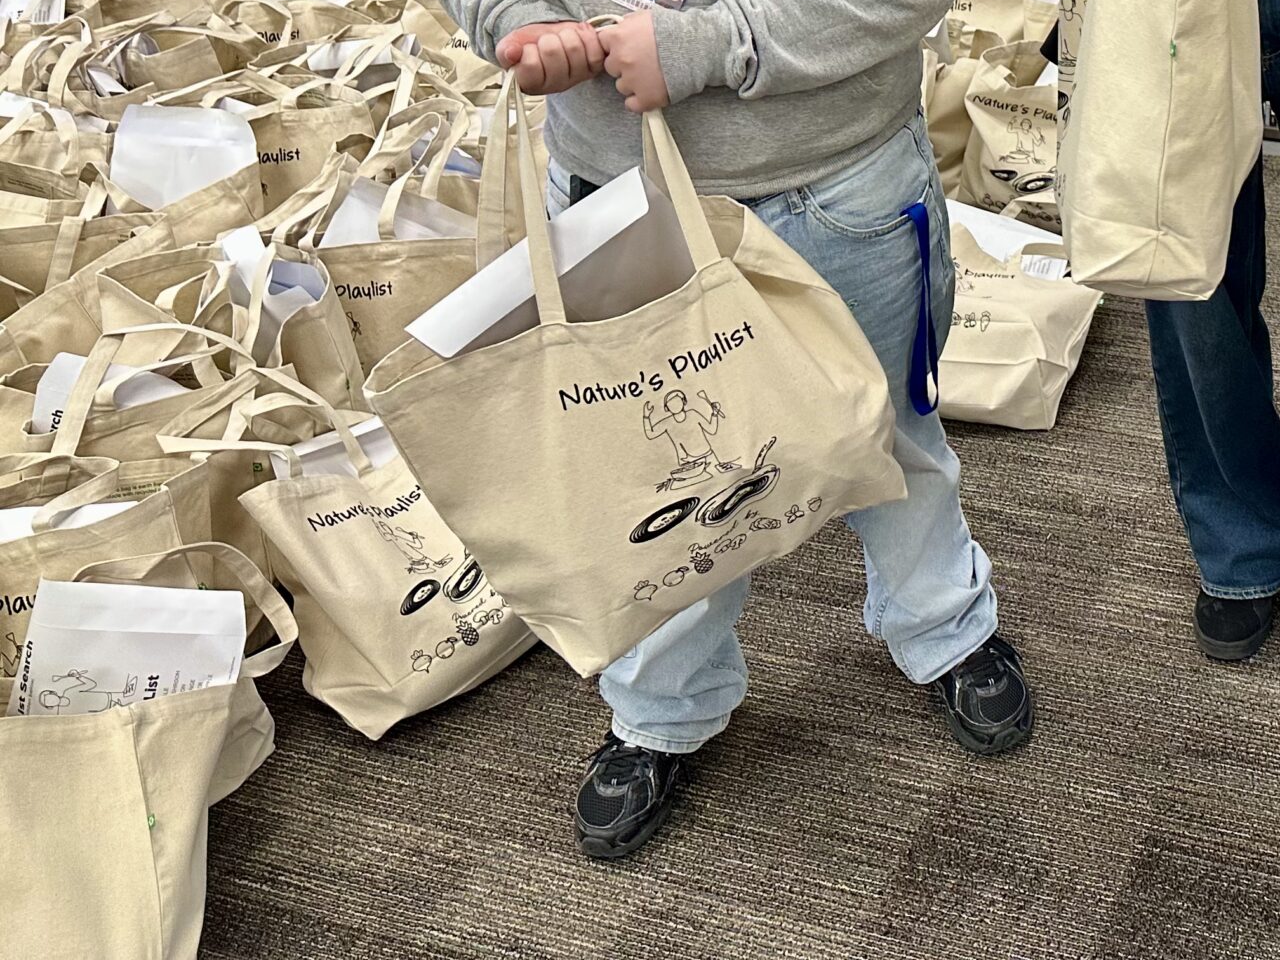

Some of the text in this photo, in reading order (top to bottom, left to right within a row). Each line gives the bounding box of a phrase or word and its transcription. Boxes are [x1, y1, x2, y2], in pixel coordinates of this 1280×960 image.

[972, 95, 1058, 125] Nature's Play
[258, 148, 301, 165] laylist
[335, 281, 393, 300] Playlist
[559, 321, 756, 411] Nature's Playlist
[45, 407, 64, 433] rch
[307, 485, 422, 532] Nature's Playlis
[19, 640, 34, 692] Search
[142, 672, 160, 702] List
